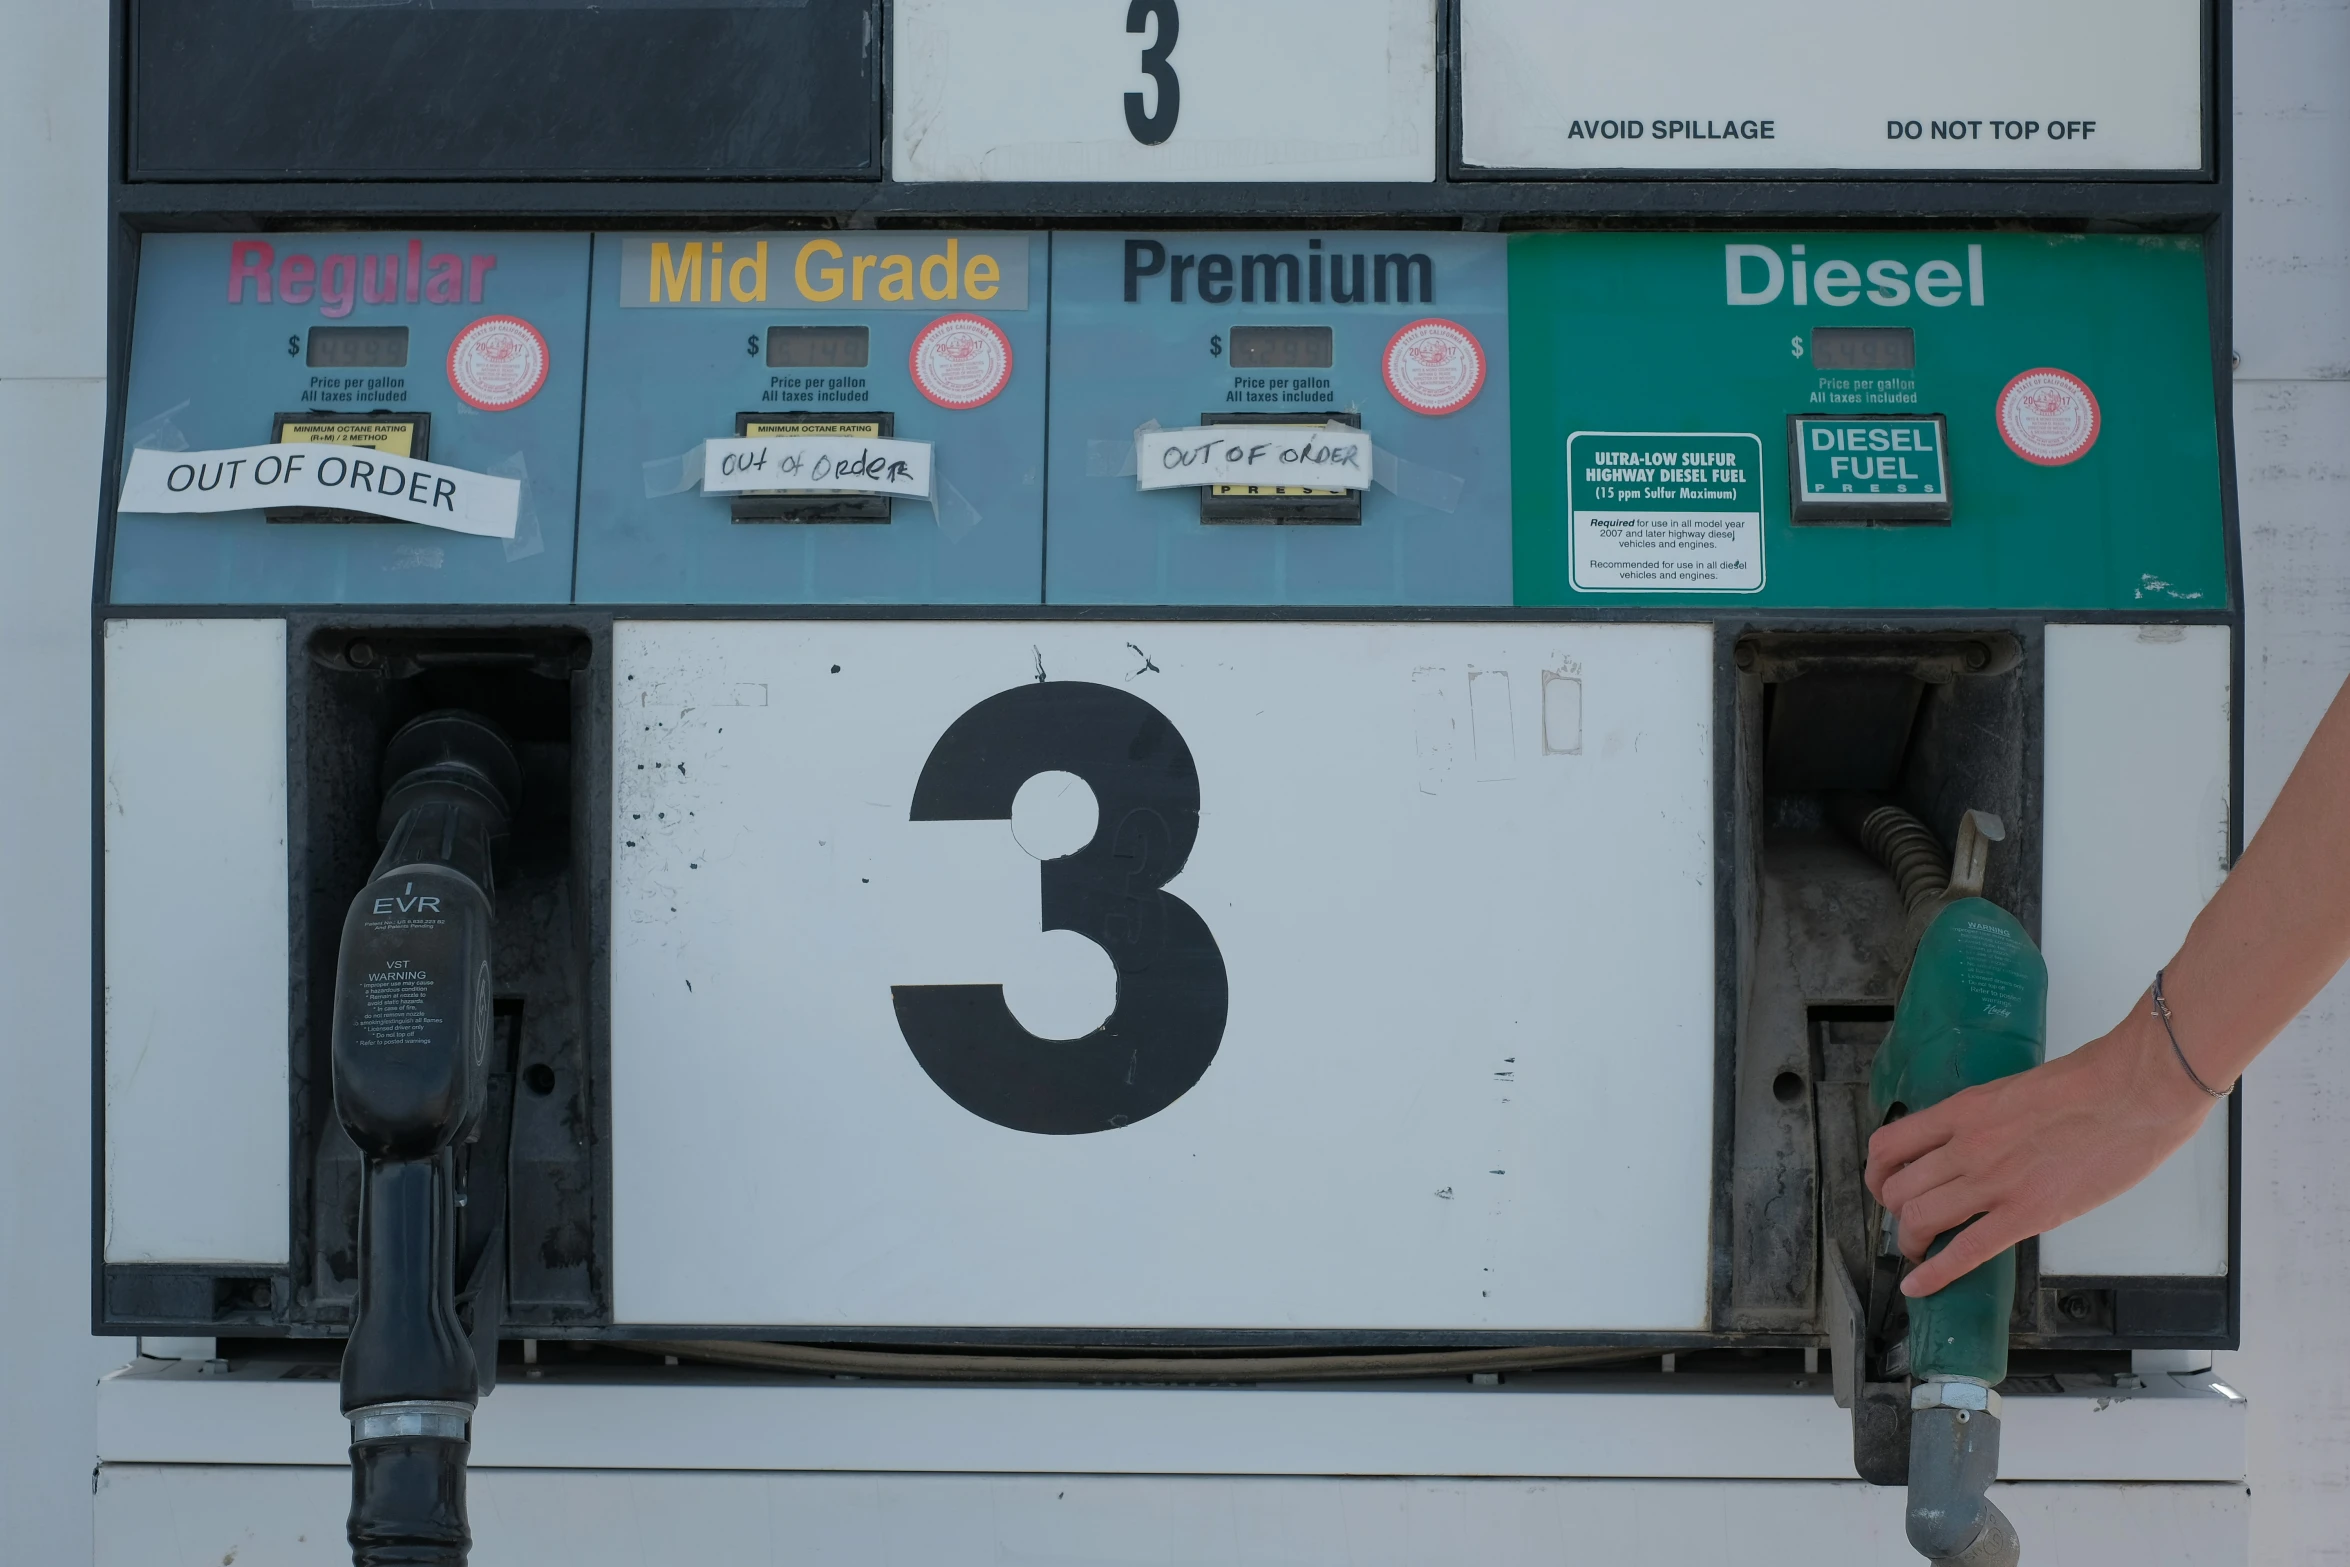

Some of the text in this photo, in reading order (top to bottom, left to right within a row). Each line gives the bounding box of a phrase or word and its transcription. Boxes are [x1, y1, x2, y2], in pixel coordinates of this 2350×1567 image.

[1124, 0, 1180, 146] 3
[1567, 120, 1775, 139] AVOID SPILLAGE
[1887, 121, 2096, 140] DO NOT TOP OFF
[649, 238, 1000, 302] Mid Grade
[1124, 238, 1435, 304] Premium
[1725, 244, 1984, 307] Diesel
[228, 238, 497, 318] Regular
[288, 335, 300, 357] $
[747, 334, 759, 357] $
[1210, 335, 1222, 358] $
[1791, 335, 1804, 359] $
[310, 376, 404, 390] Price per gallon
[771, 376, 865, 390] Price per gallon
[1234, 377, 1330, 390] Price per gallon
[1819, 378, 1915, 391] Price per gallon
[301, 390, 407, 401] All taxes included
[762, 390, 868, 401] All taxes included
[1226, 391, 1334, 402] All taxes included
[1810, 392, 1917, 403] All taxes included
[1811, 428, 1933, 452] DIESEL
[1163, 439, 1360, 471] OUT OF ORDER
[1595, 452, 1736, 467] ULTRA-LOW SULFUR
[1830, 456, 1919, 479] FUEL
[166, 454, 457, 512] OUT OF ORDER
[1586, 468, 1746, 483] HIGHWAY DIESEL FUEL
[1595, 487, 1737, 501] (15 ppm Sulfur Maximum)
[1815, 484, 1934, 493] PRESS
[1590, 519, 1635, 528] Required
[1637, 519, 1650, 528] for
[1670, 520, 1679, 528] in
[1681, 520, 1692, 528] all
[1694, 520, 1723, 528] model
[1725, 521, 1745, 530] year
[1600, 529, 1735, 540] 2007 and later highway diesel
[1619, 540, 1717, 550] vehicles and engines.
[1590, 560, 1659, 569] Recommended
[1662, 560, 1674, 569] for
[1696, 561, 1704, 569] in
[1706, 561, 1717, 569] all
[1719, 560, 1747, 570] diesel
[1619, 571, 1718, 581] vehicles and engines.
[373, 896, 440, 914] EVR
[891, 680, 1229, 1135] 3
[1968, 921, 2011, 937] WARNING
[386, 960, 410, 969] VST
[368, 971, 426, 982] WARNING
[1983, 1004, 2012, 1018] Husky
